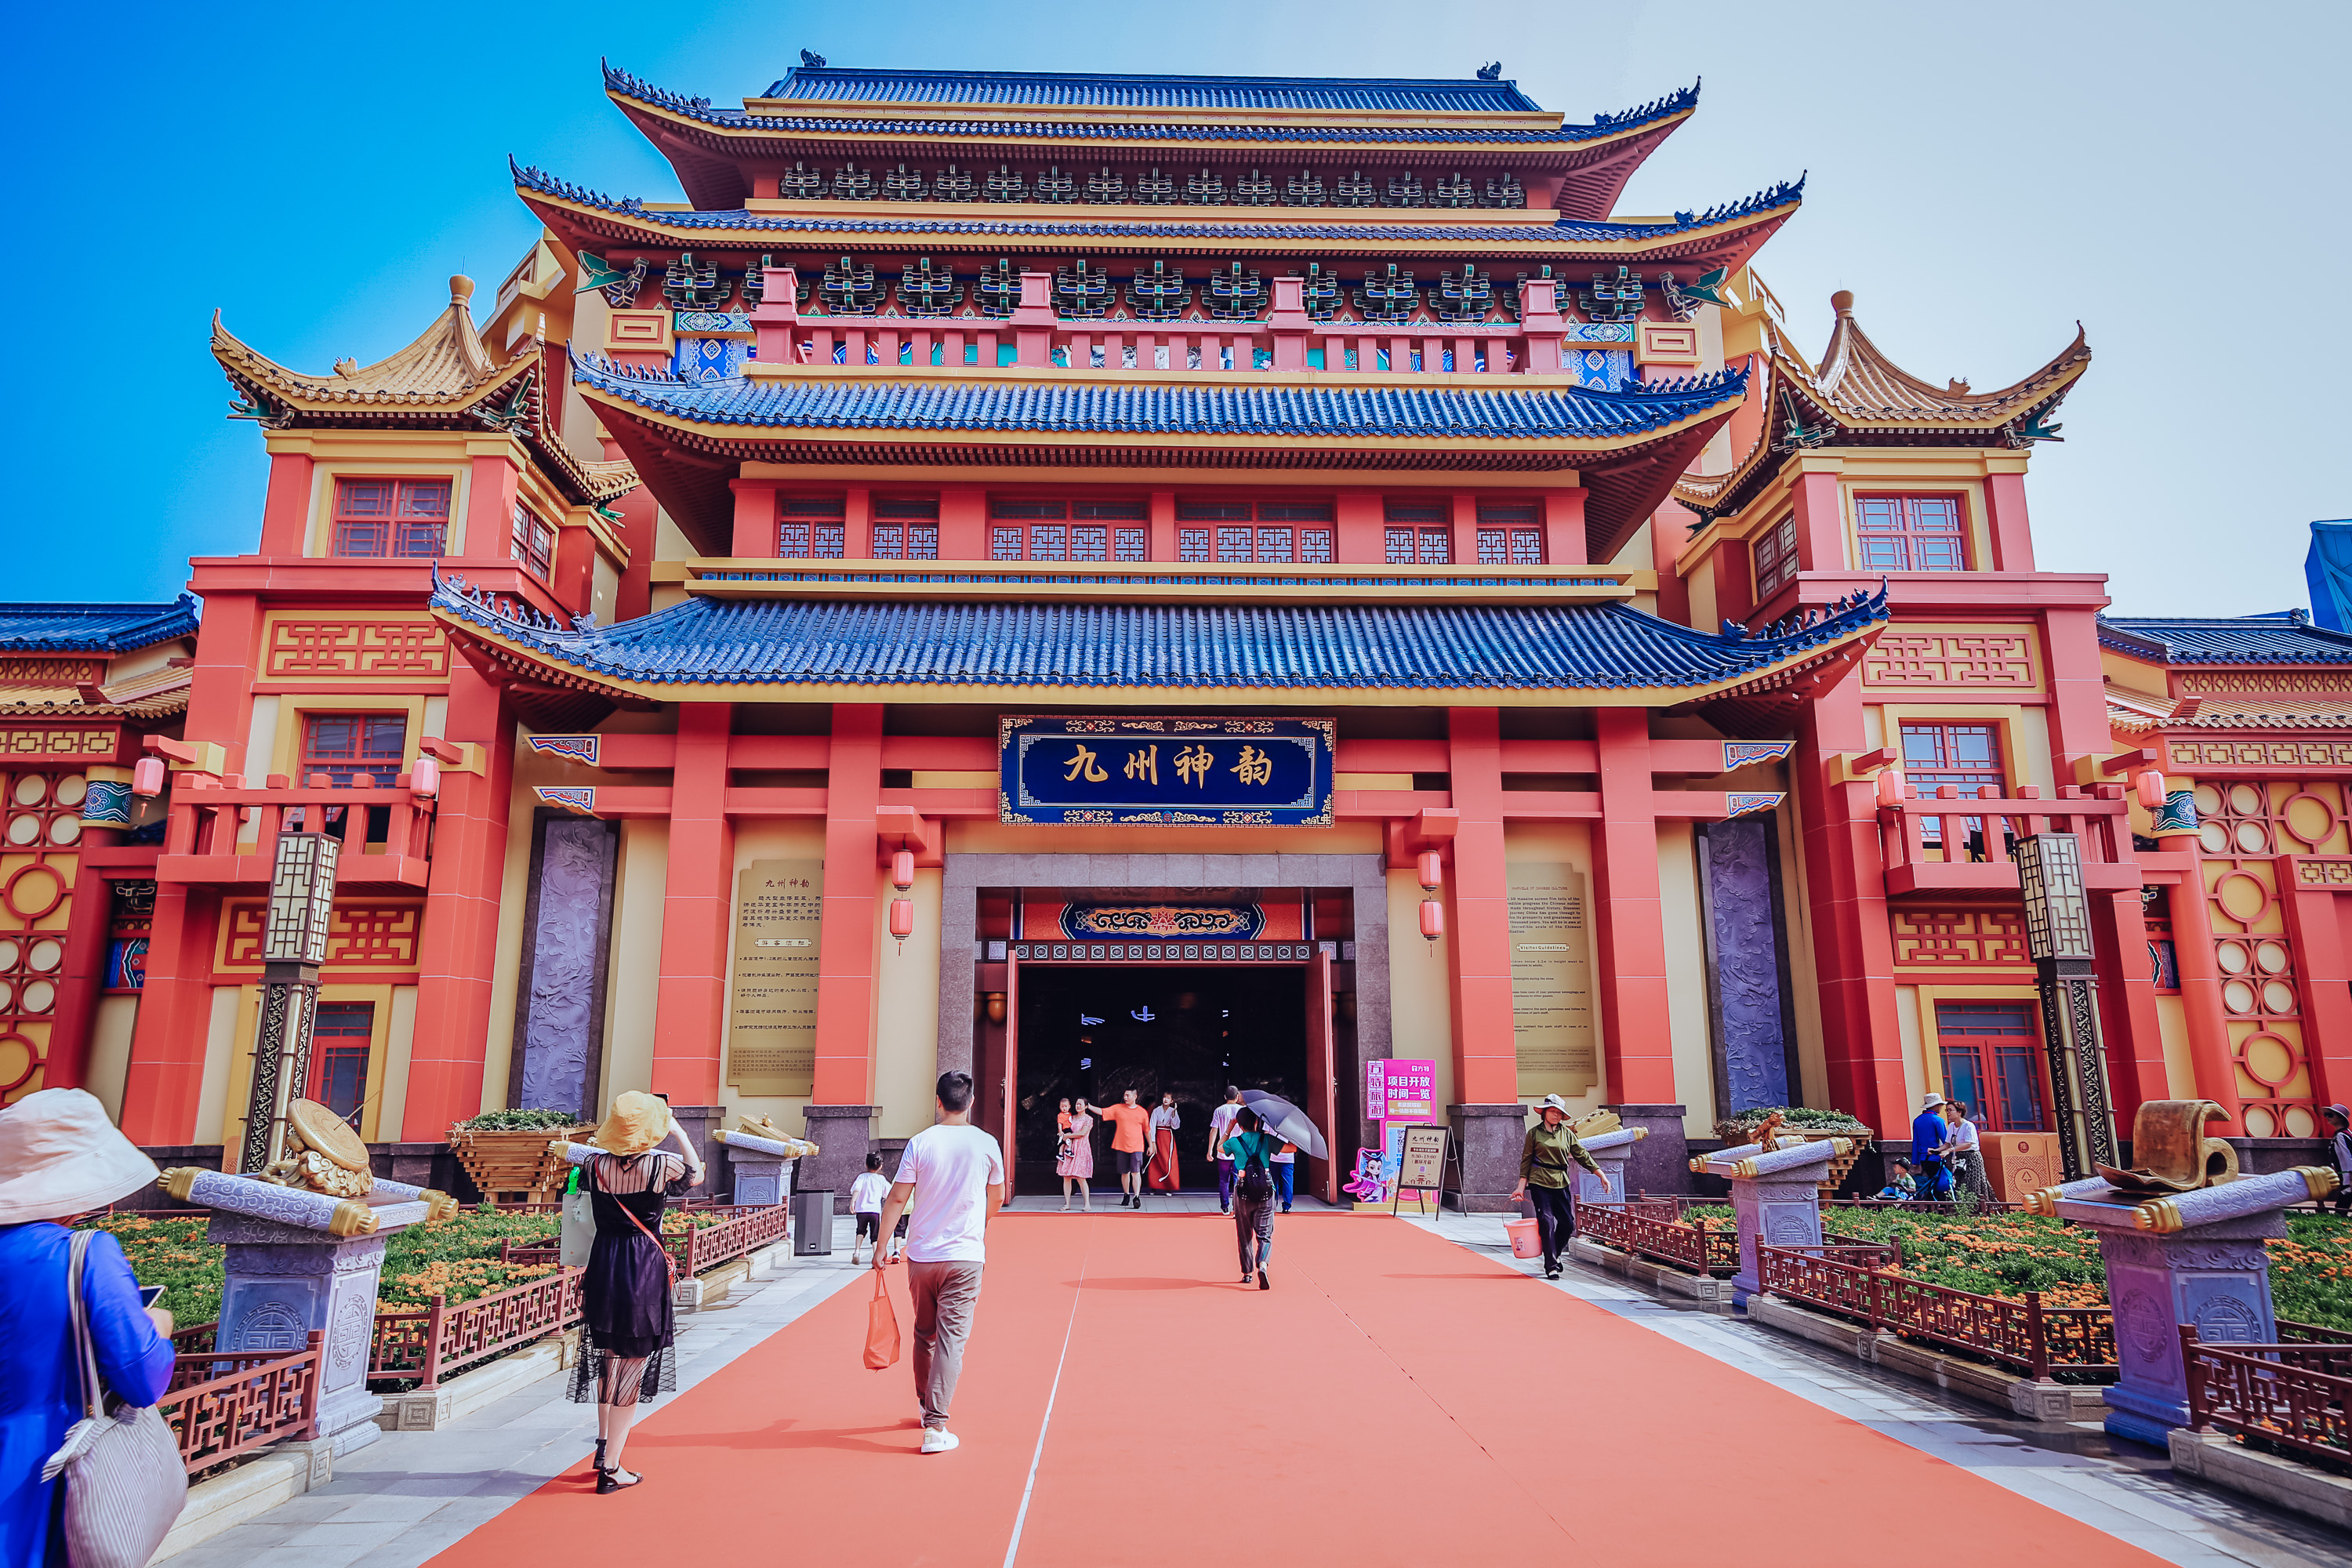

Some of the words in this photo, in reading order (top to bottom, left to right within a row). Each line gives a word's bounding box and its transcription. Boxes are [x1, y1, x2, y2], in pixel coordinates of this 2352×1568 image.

[1064, 744, 1273, 789] 九州神韵
[766, 878, 810, 889] 九州神韵
[1387, 1076, 1431, 1087] 项目开放
[1370, 1064, 1381, 1115] 方特旅游
[1388, 1088, 1431, 1099] 时间一览
